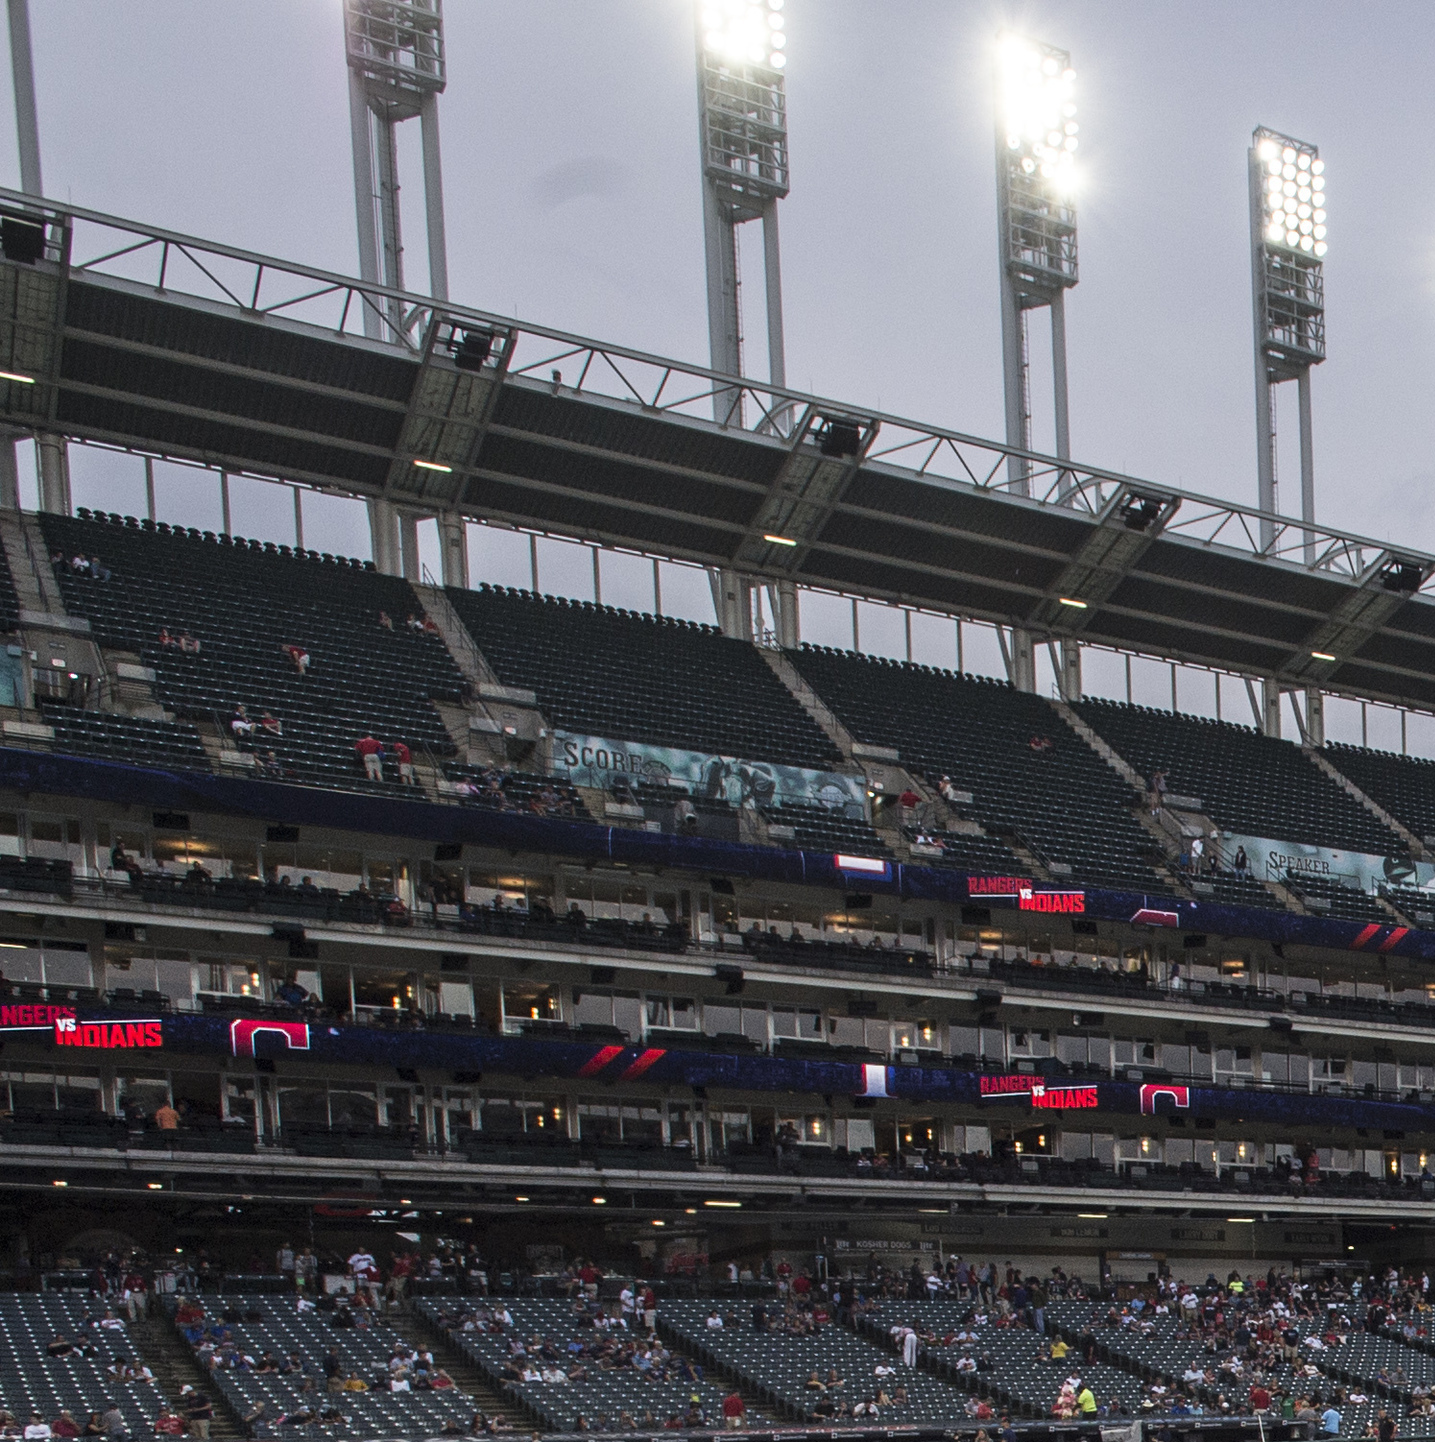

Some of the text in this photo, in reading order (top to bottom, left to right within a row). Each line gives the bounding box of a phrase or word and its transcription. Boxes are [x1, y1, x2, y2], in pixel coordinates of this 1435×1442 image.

[563, 742, 643, 776] SCORE
[1268, 850, 1331, 875] SPEAKER
[968, 876, 1033, 894] RANGERS
[1019, 888, 1032, 900] VS
[1019, 893, 1085, 913] INDIANS
[56, 1018, 76, 1032] VS
[55, 1022, 162, 1049] INDIANS
[980, 1075, 1046, 1094] RANGERS
[1031, 1086, 1045, 1097] VS
[1031, 1088, 1099, 1109] INDIANS
[856, 1240, 888, 1249] KOSHER
